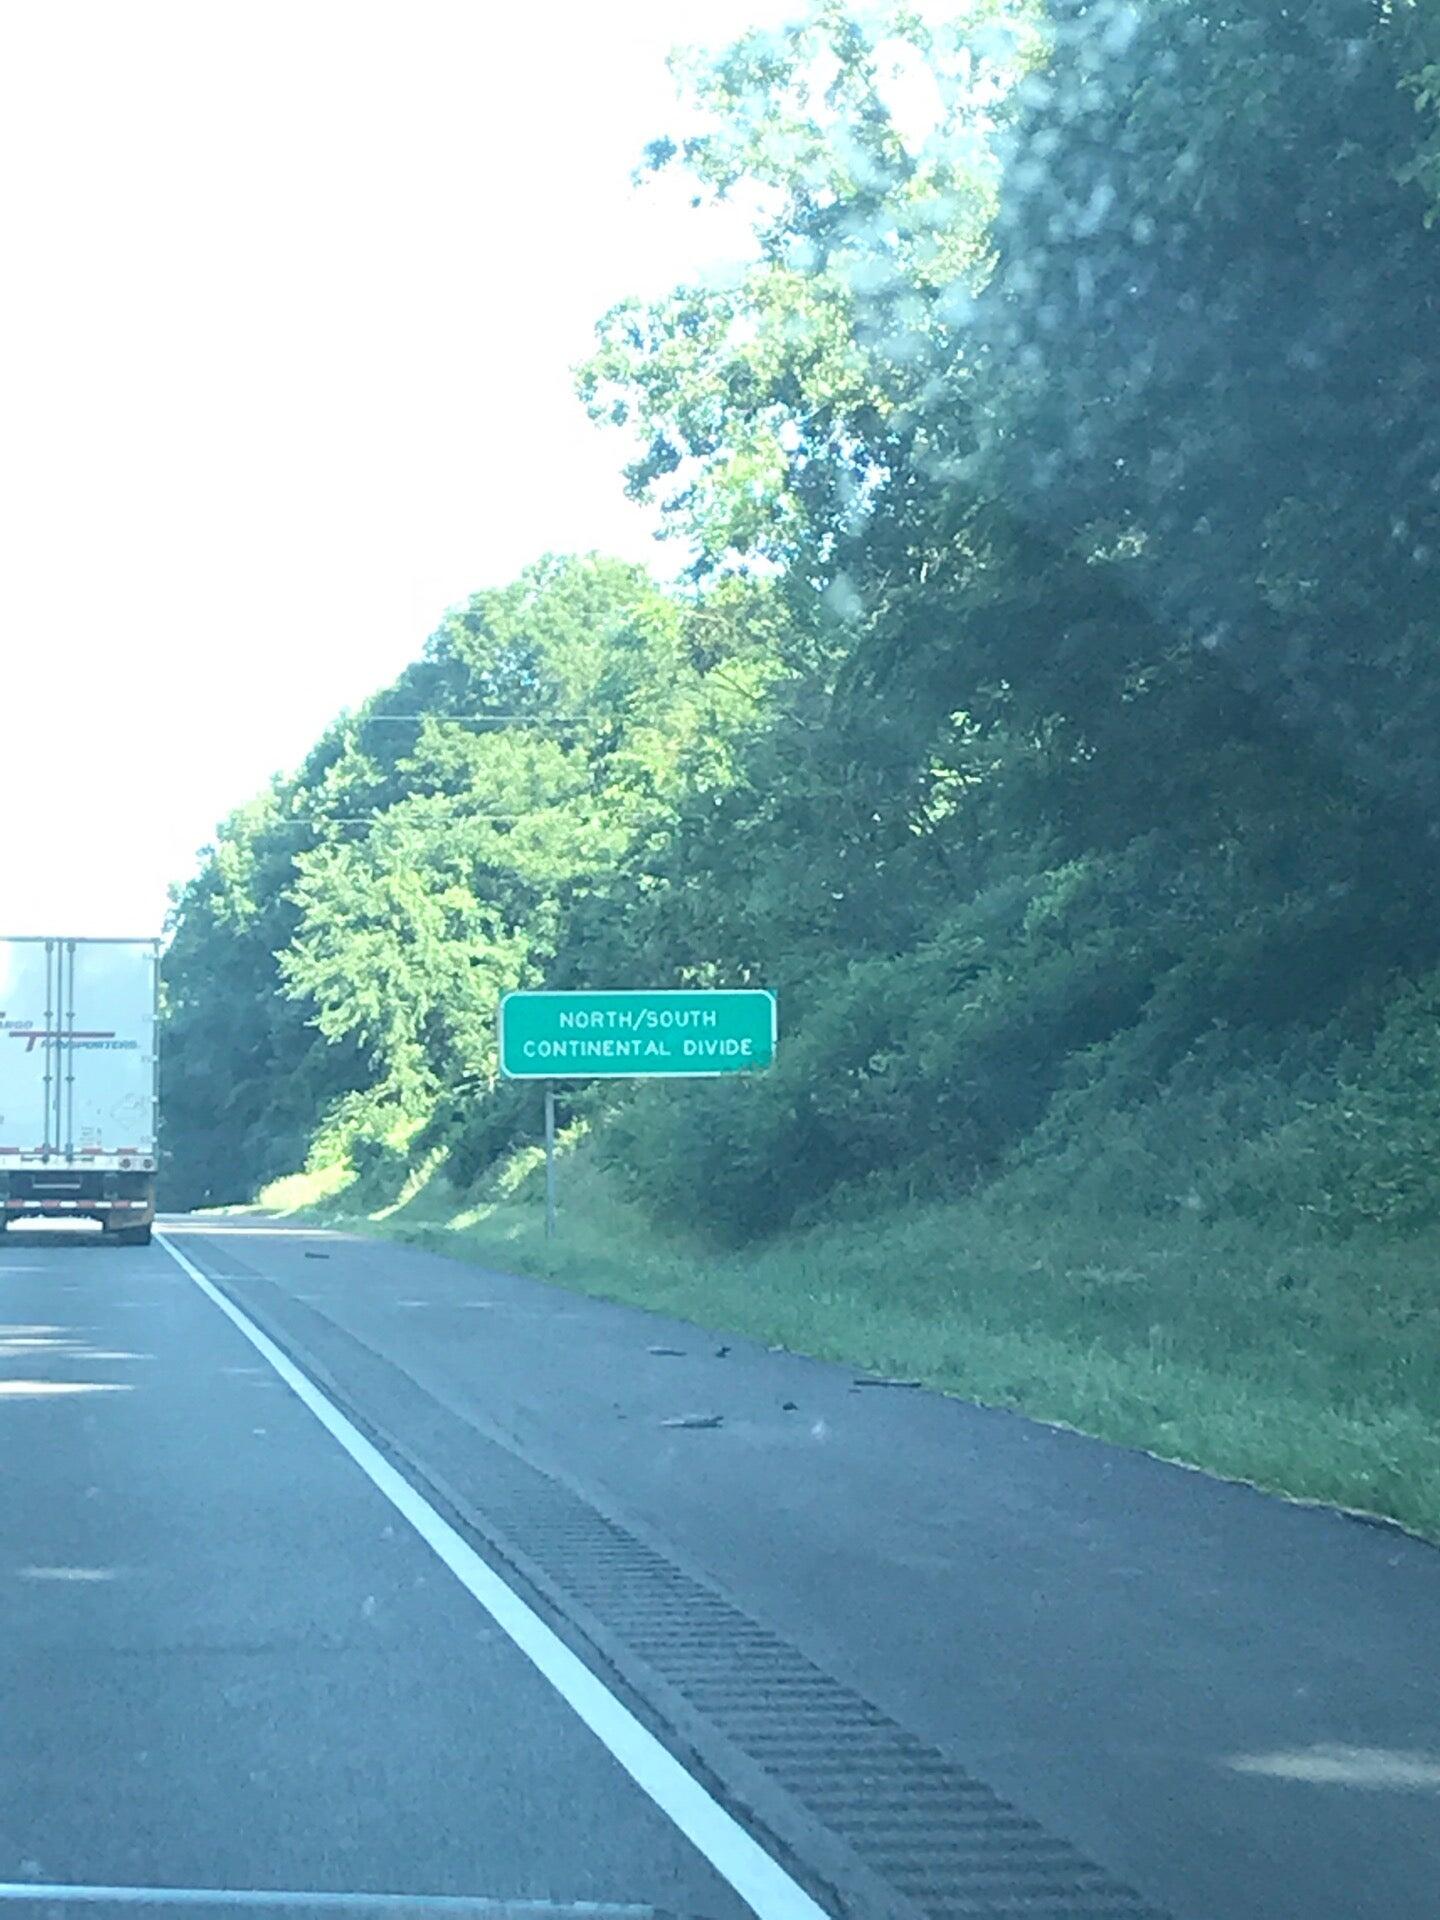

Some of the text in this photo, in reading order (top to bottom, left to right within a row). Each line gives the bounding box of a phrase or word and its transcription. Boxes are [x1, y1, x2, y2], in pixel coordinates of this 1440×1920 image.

[559, 1009, 717, 1031] NORTH/SOUTH
[523, 1038, 753, 1058] CONTINENTAL DIVIDE
